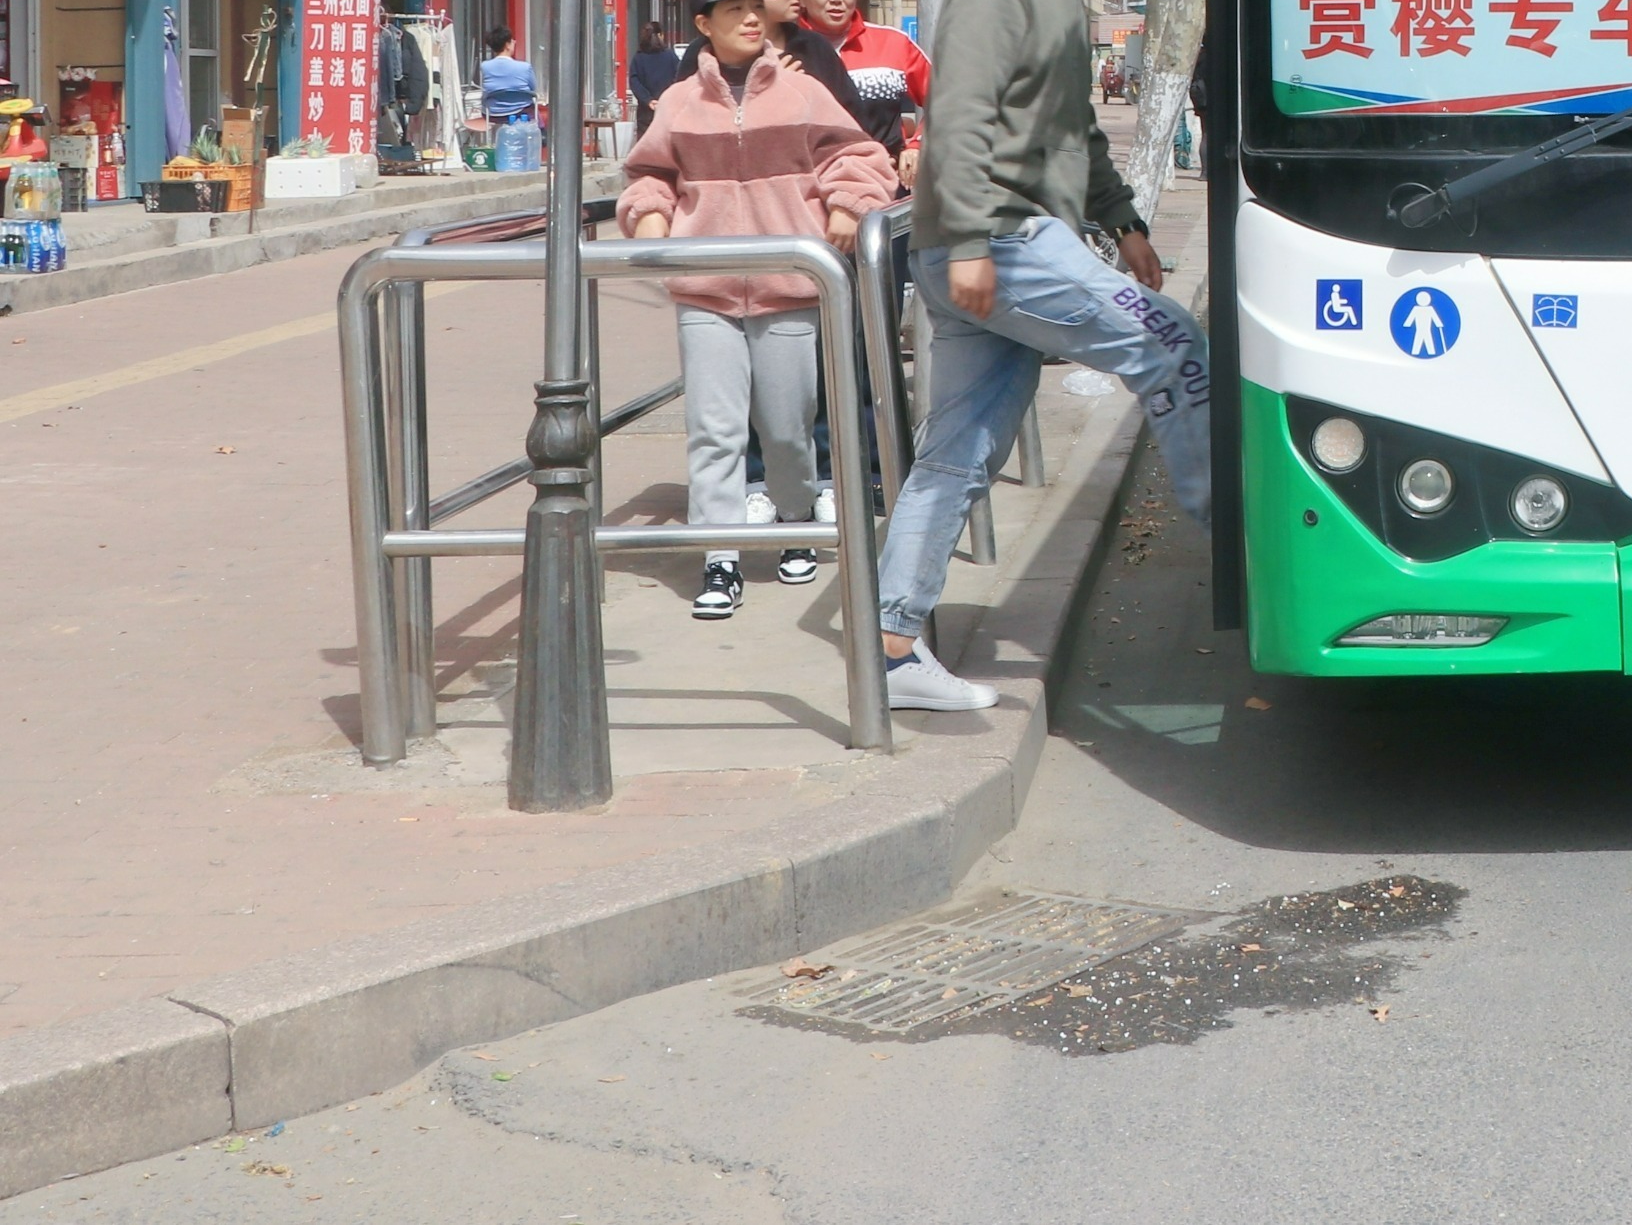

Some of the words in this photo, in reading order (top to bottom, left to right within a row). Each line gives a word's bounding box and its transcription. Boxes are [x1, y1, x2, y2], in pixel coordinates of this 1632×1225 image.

[310, 22, 368, 53] 刀削面
[308, 57, 366, 88] 盖浇饭
[1113, 287, 1193, 353] BREAK
